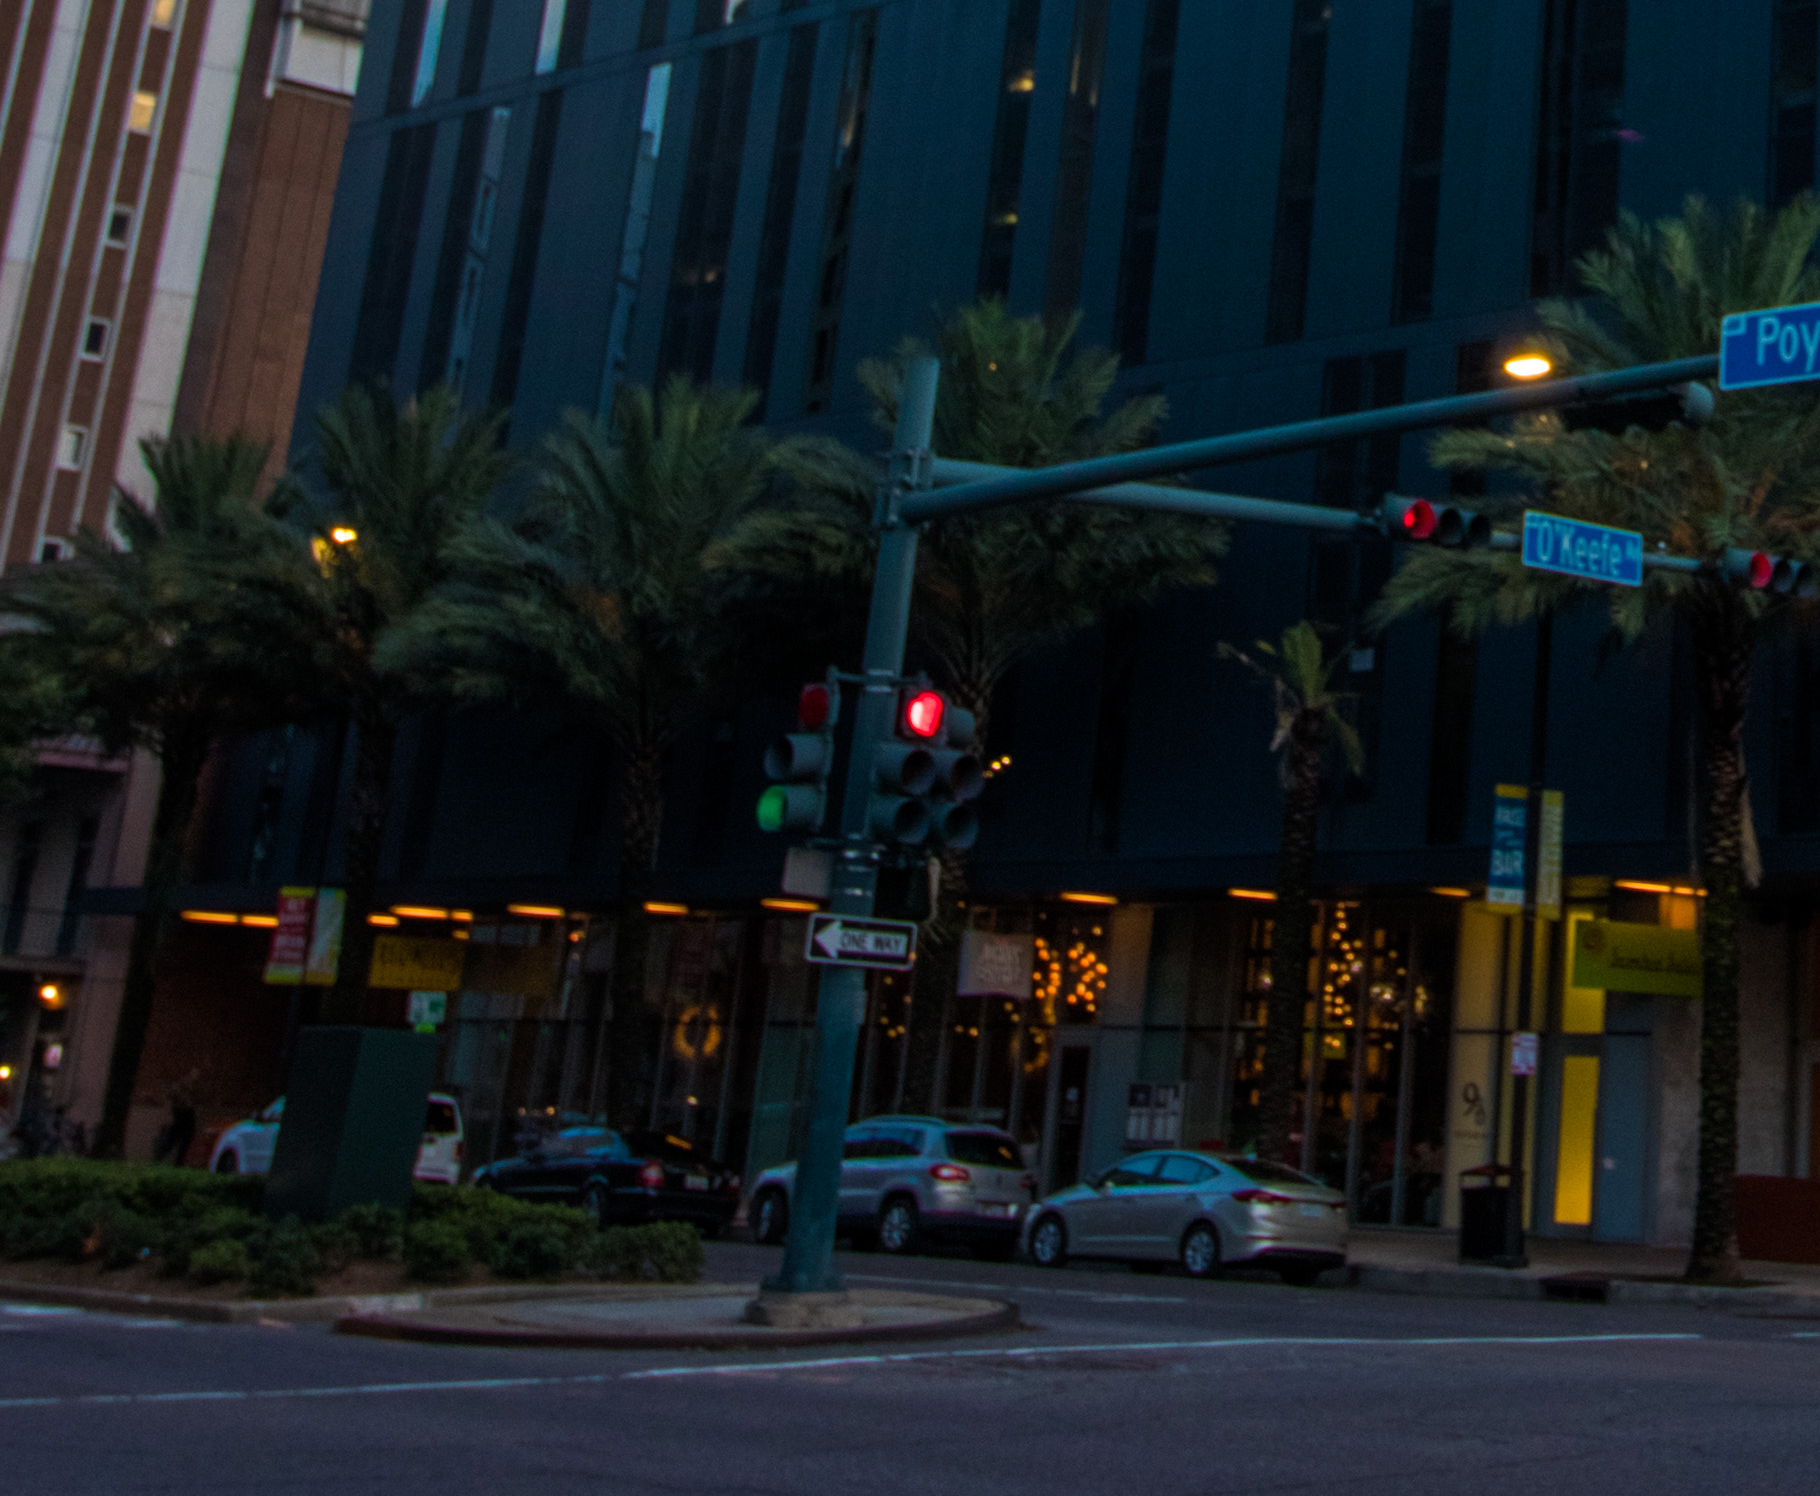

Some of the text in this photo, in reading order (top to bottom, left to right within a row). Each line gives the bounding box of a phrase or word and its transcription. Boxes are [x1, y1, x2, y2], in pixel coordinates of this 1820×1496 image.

[1536, 520, 1622, 577] O'Keefe
[840, 930, 902, 954] ONE WAY
